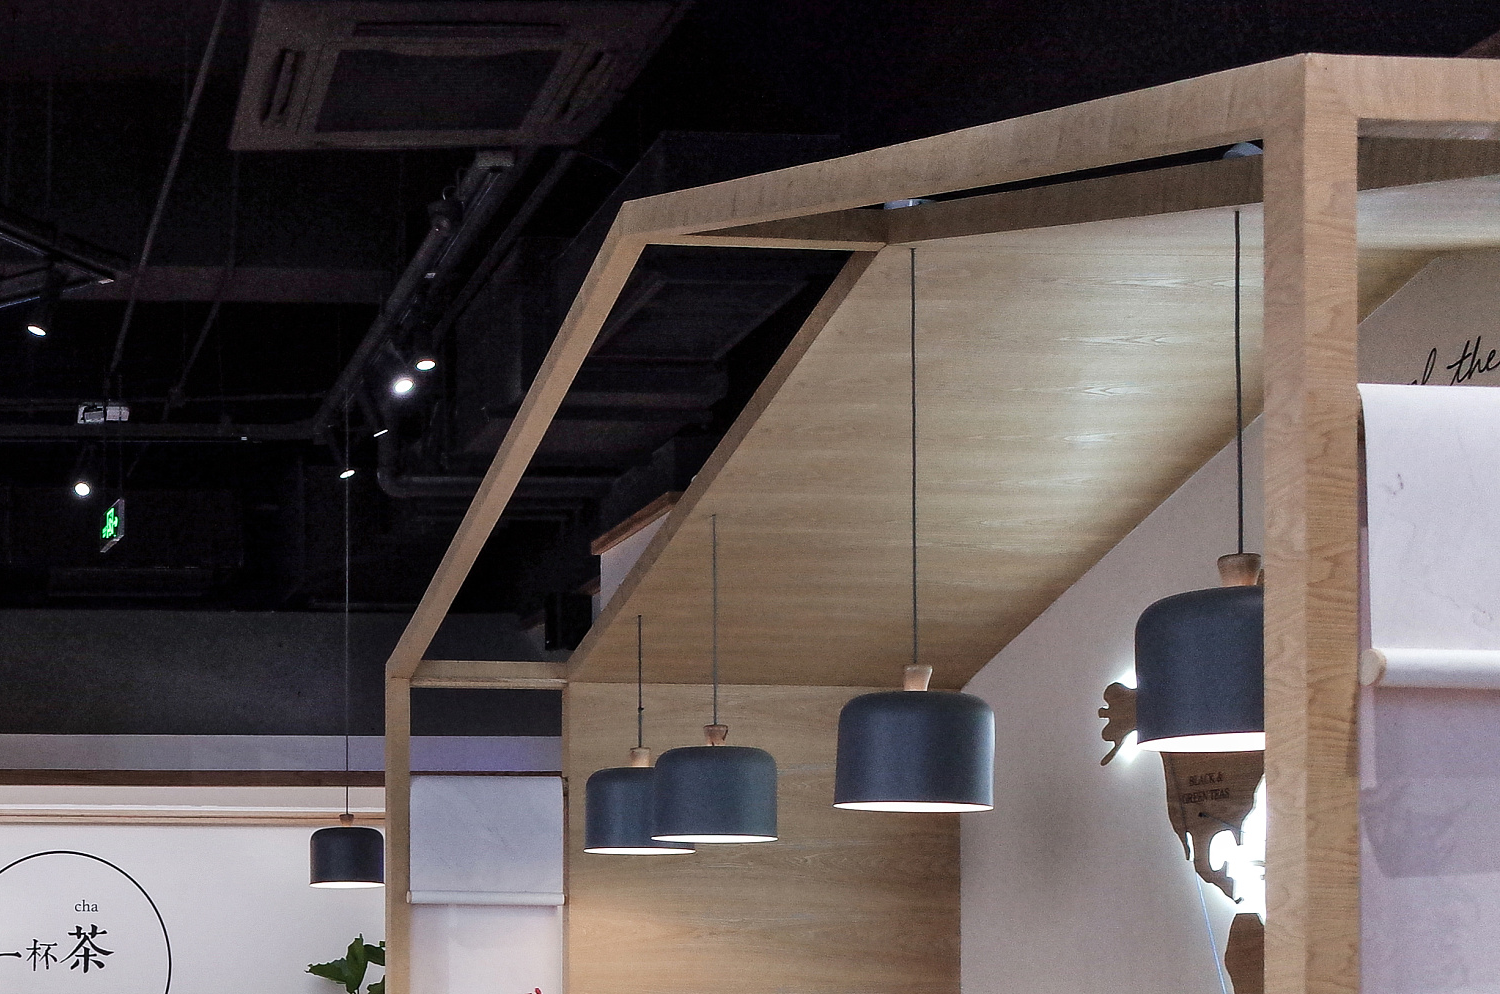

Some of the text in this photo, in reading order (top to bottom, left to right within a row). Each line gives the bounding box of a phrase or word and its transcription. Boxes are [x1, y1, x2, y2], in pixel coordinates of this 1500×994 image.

[1189, 772, 1215, 786] BLACK
[1181, 787, 1230, 804] GREEN TEAS
[74, 899, 99, 912] cha
